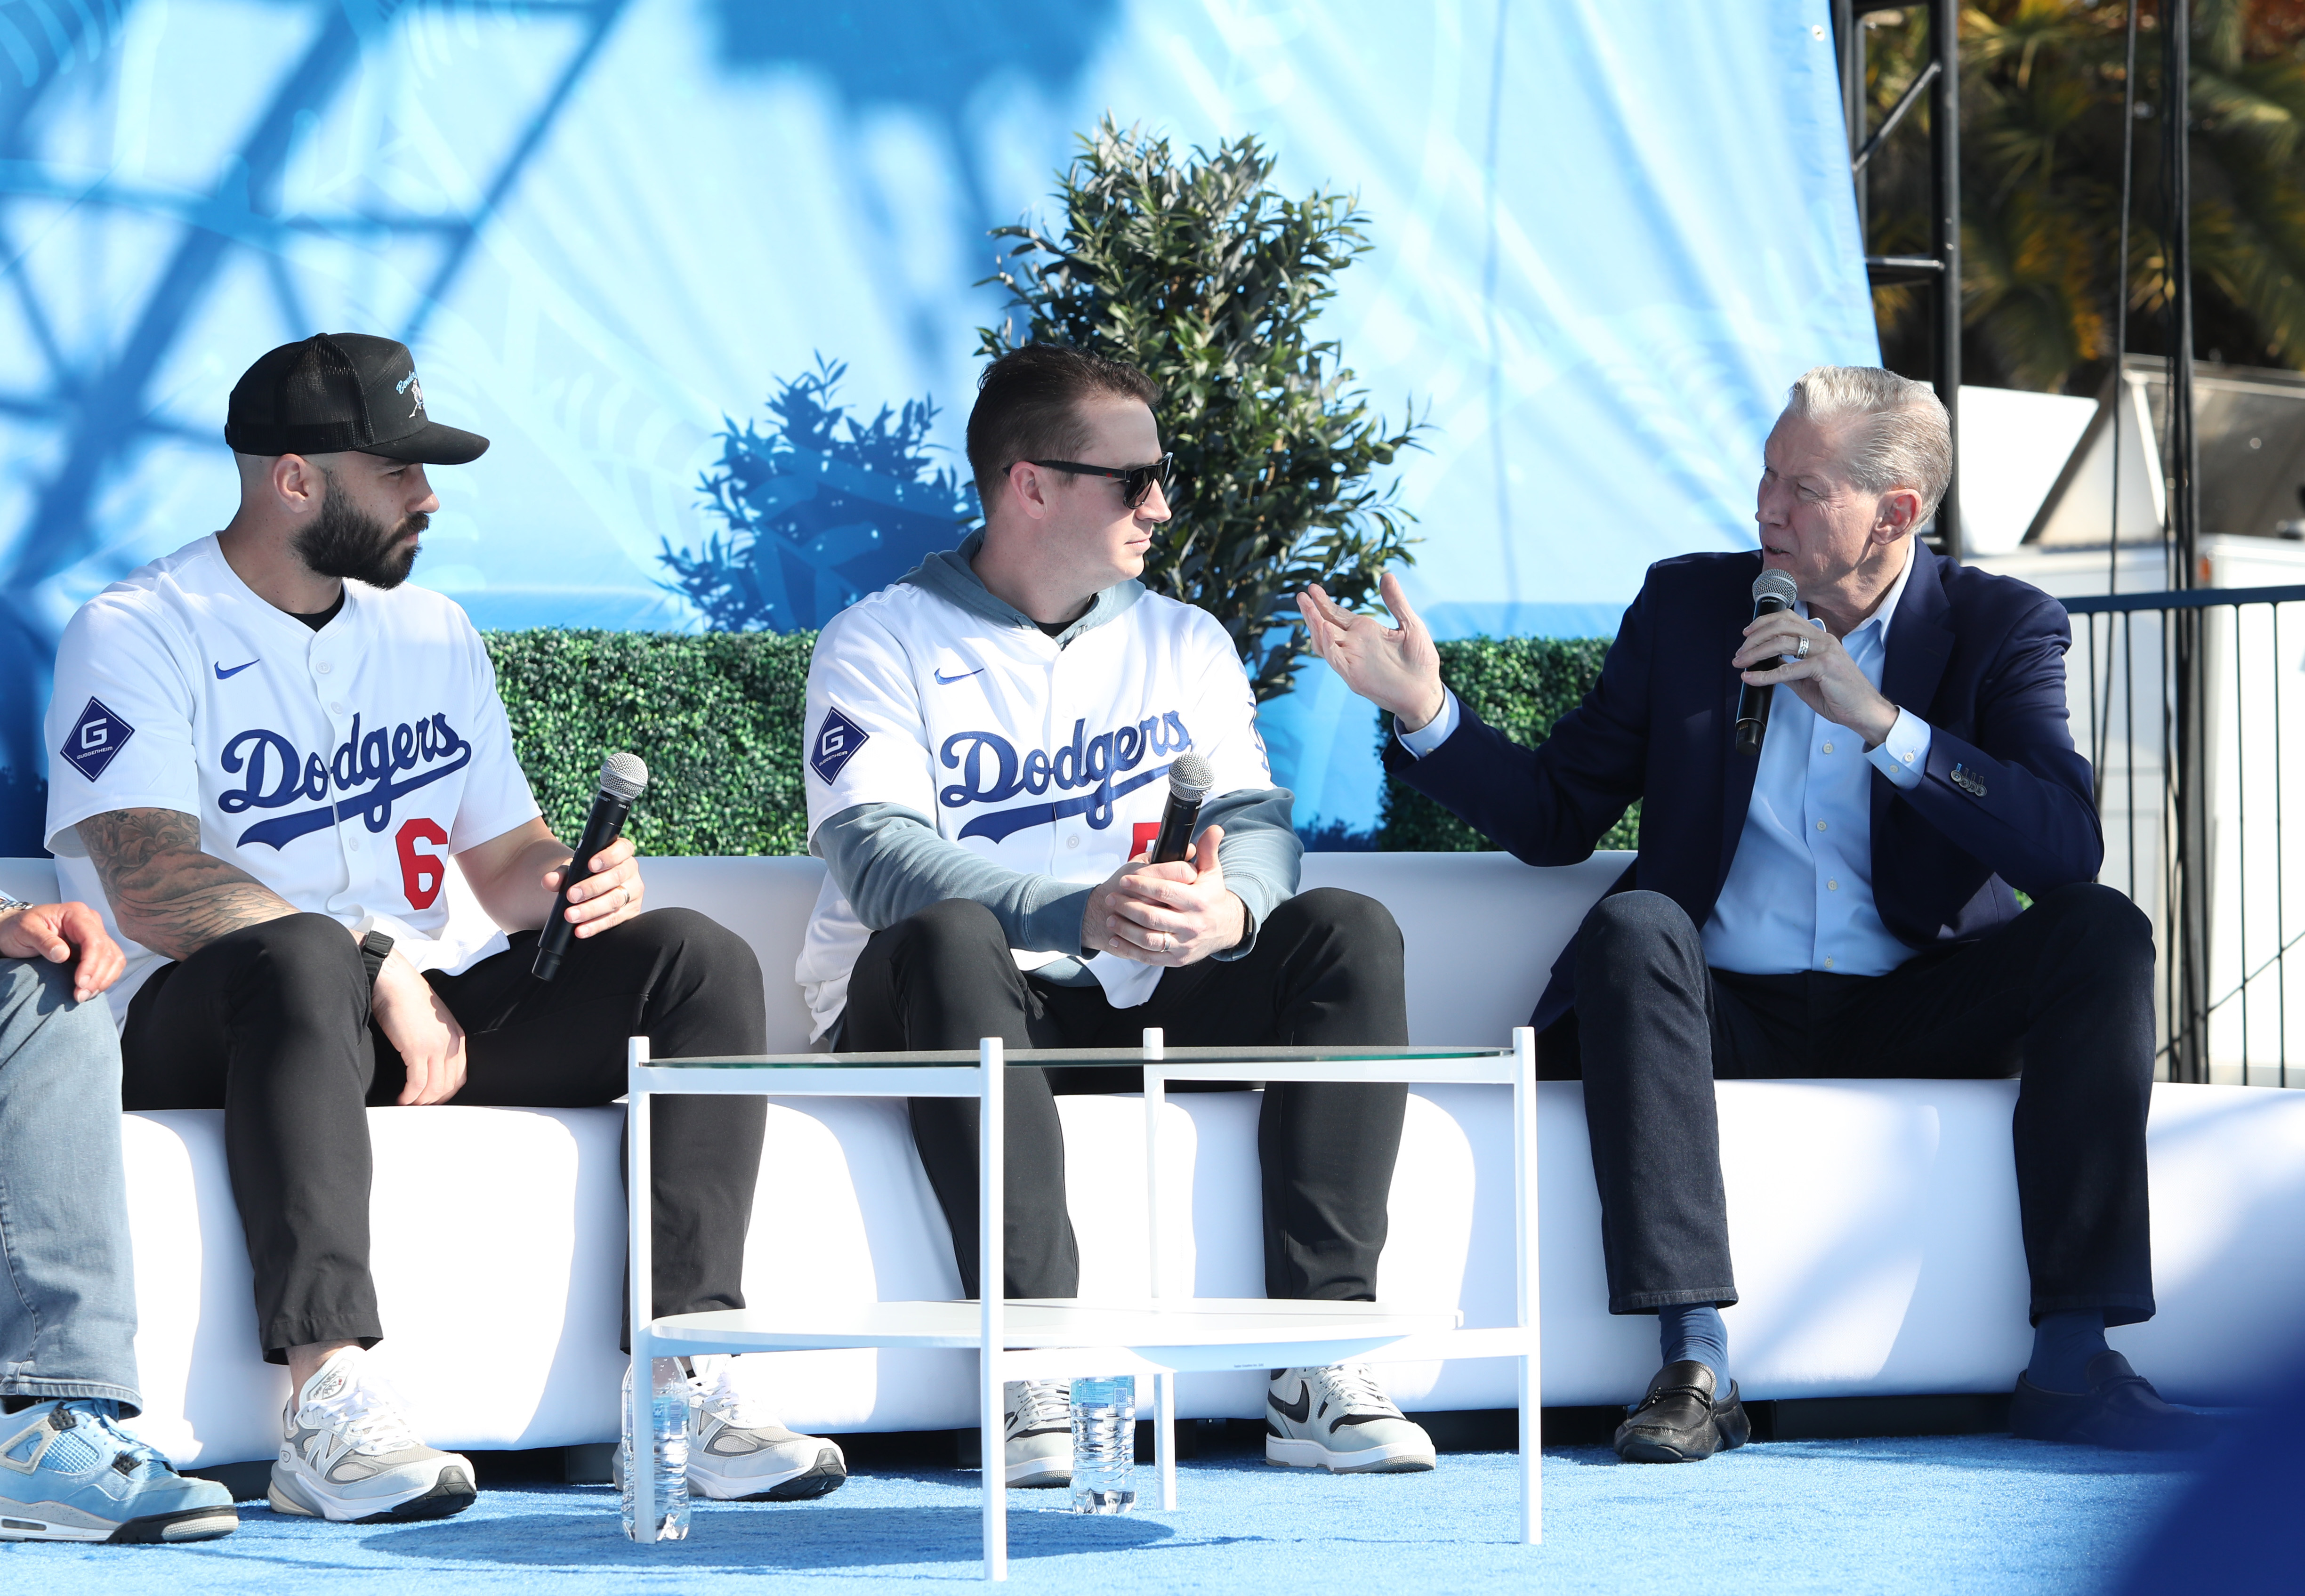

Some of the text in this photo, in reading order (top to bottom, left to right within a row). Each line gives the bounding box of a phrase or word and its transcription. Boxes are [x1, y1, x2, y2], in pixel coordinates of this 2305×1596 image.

[81, 717, 107, 750] G
[822, 725, 844, 756] G
[77, 746, 113, 759] GUGGENHEIM
[819, 750, 848, 767] GUGGENHEIM
[218, 712, 471, 833] Dodgers
[939, 710, 1192, 830] Dodgers
[395, 818, 448, 911] 6
